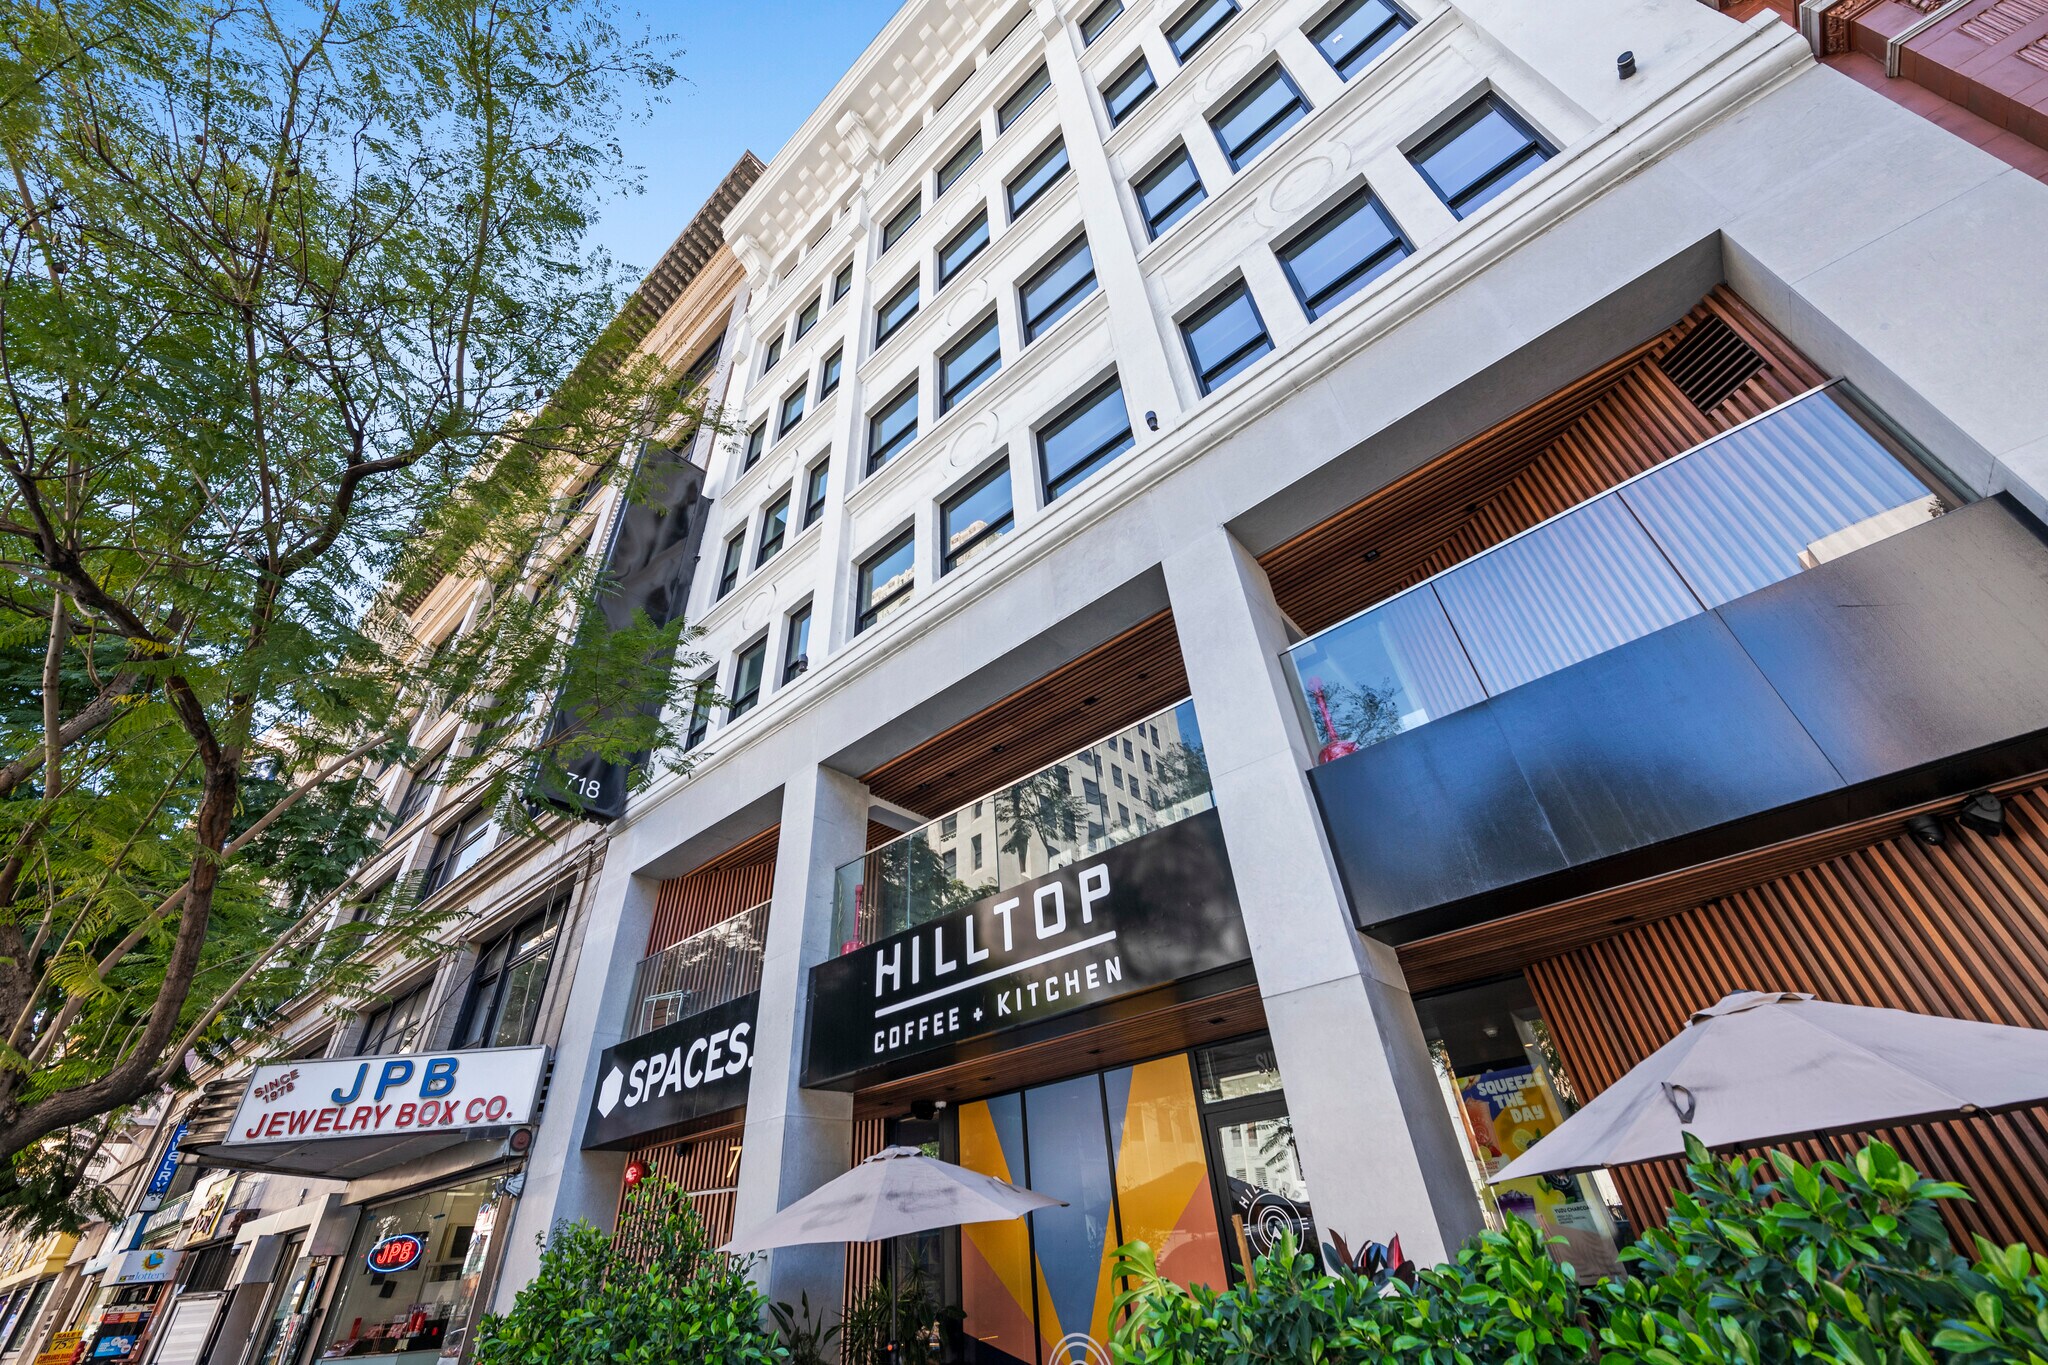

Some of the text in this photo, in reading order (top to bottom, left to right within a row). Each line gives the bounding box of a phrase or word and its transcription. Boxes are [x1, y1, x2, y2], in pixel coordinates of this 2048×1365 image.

[567, 772, 600, 798] 718
[875, 863, 1111, 997] HILLTOP
[874, 956, 1123, 1054] COFFEE + KITCHEN
[254, 1069, 300, 1098] SINCE
[262, 1082, 296, 1104] 1978
[331, 1057, 460, 1105] JPB
[1476, 1072, 1546, 1097] SQUEEZE
[1492, 1091, 1527, 1110] THE
[246, 1095, 513, 1139] JEWELRY BOX CO.
[1509, 1104, 1546, 1124] DAY
[726, 1145, 742, 1179] 7
[376, 1241, 413, 1264] JPB
[134, 1271, 167, 1280] lottery
